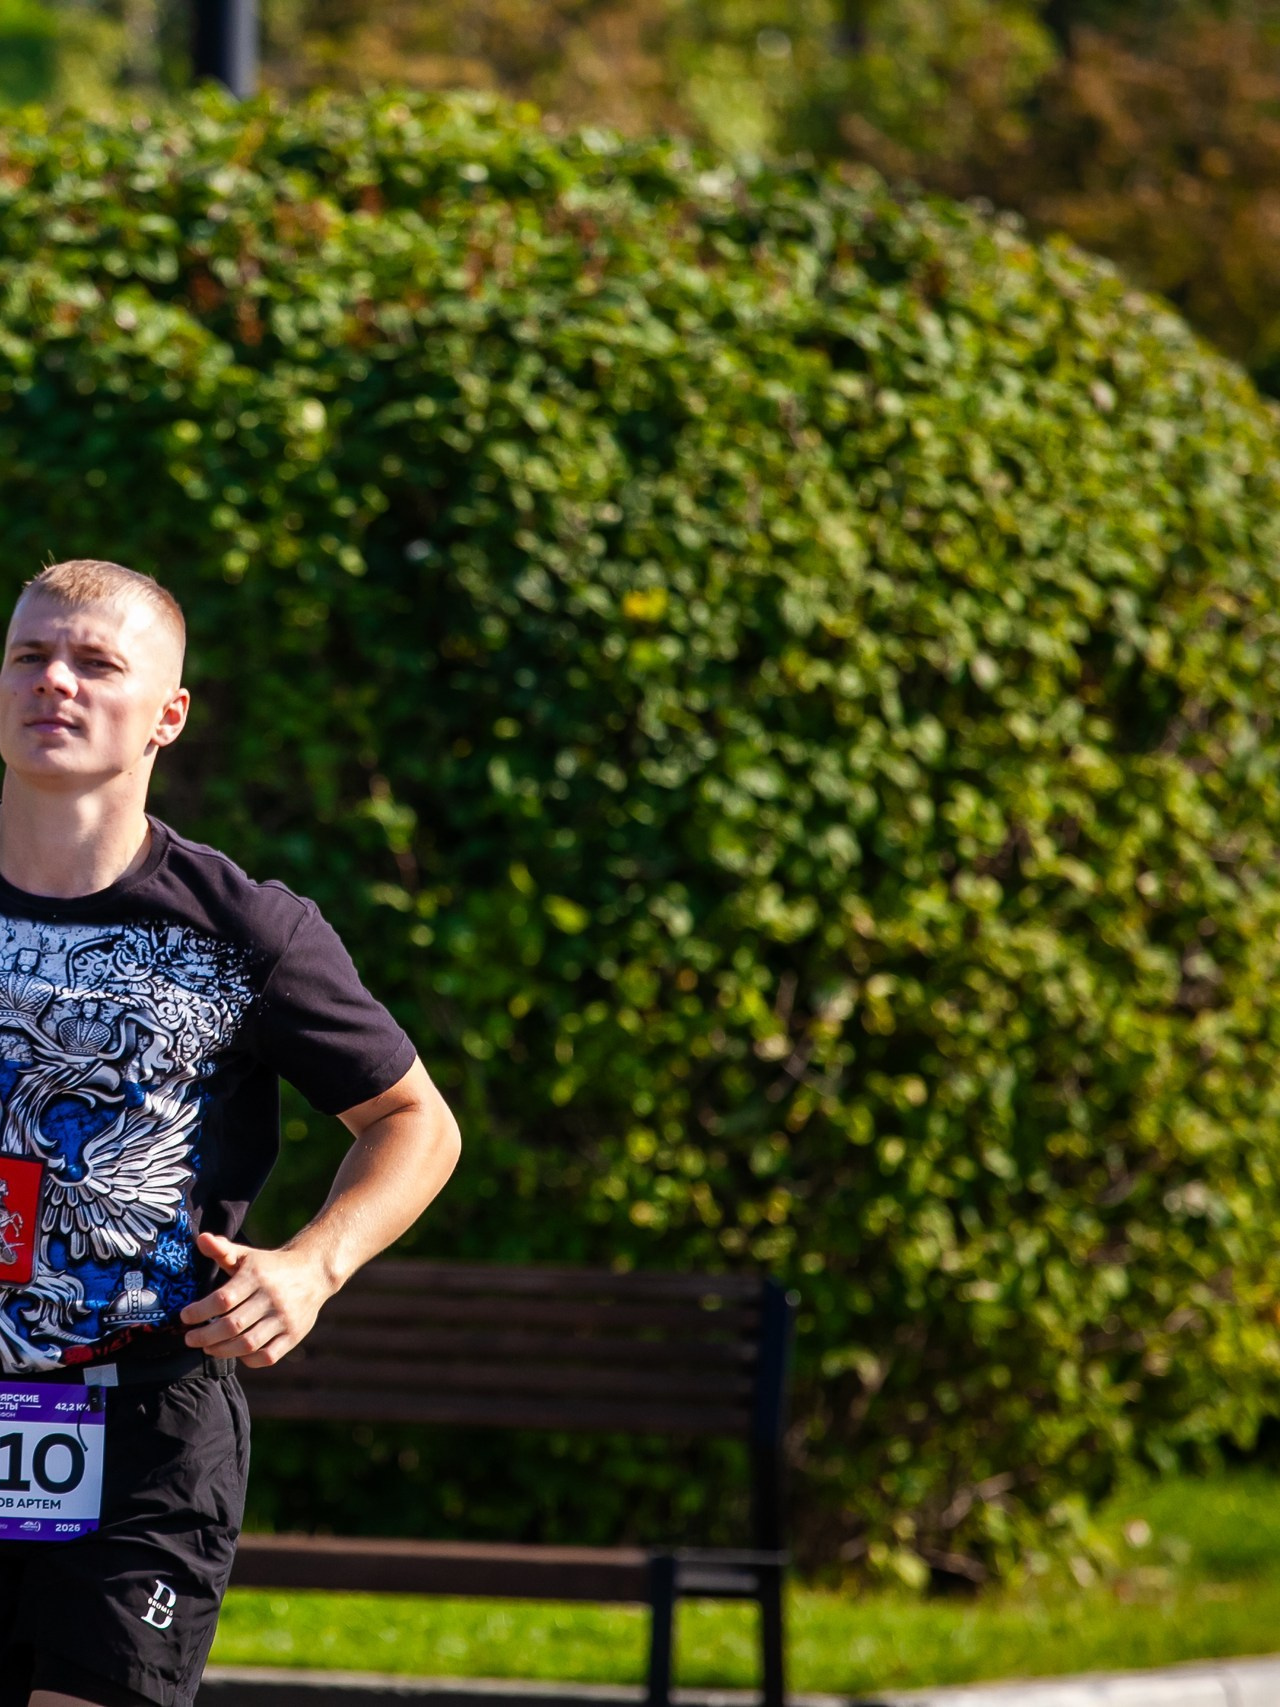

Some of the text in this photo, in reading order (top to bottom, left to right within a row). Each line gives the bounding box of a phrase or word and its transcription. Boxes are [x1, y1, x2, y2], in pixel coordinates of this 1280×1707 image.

[54, 1402, 75, 1412] 42,2
[17, 1498, 61, 1510] АРТЕМ
[55, 1523, 81, 1532] 2026
